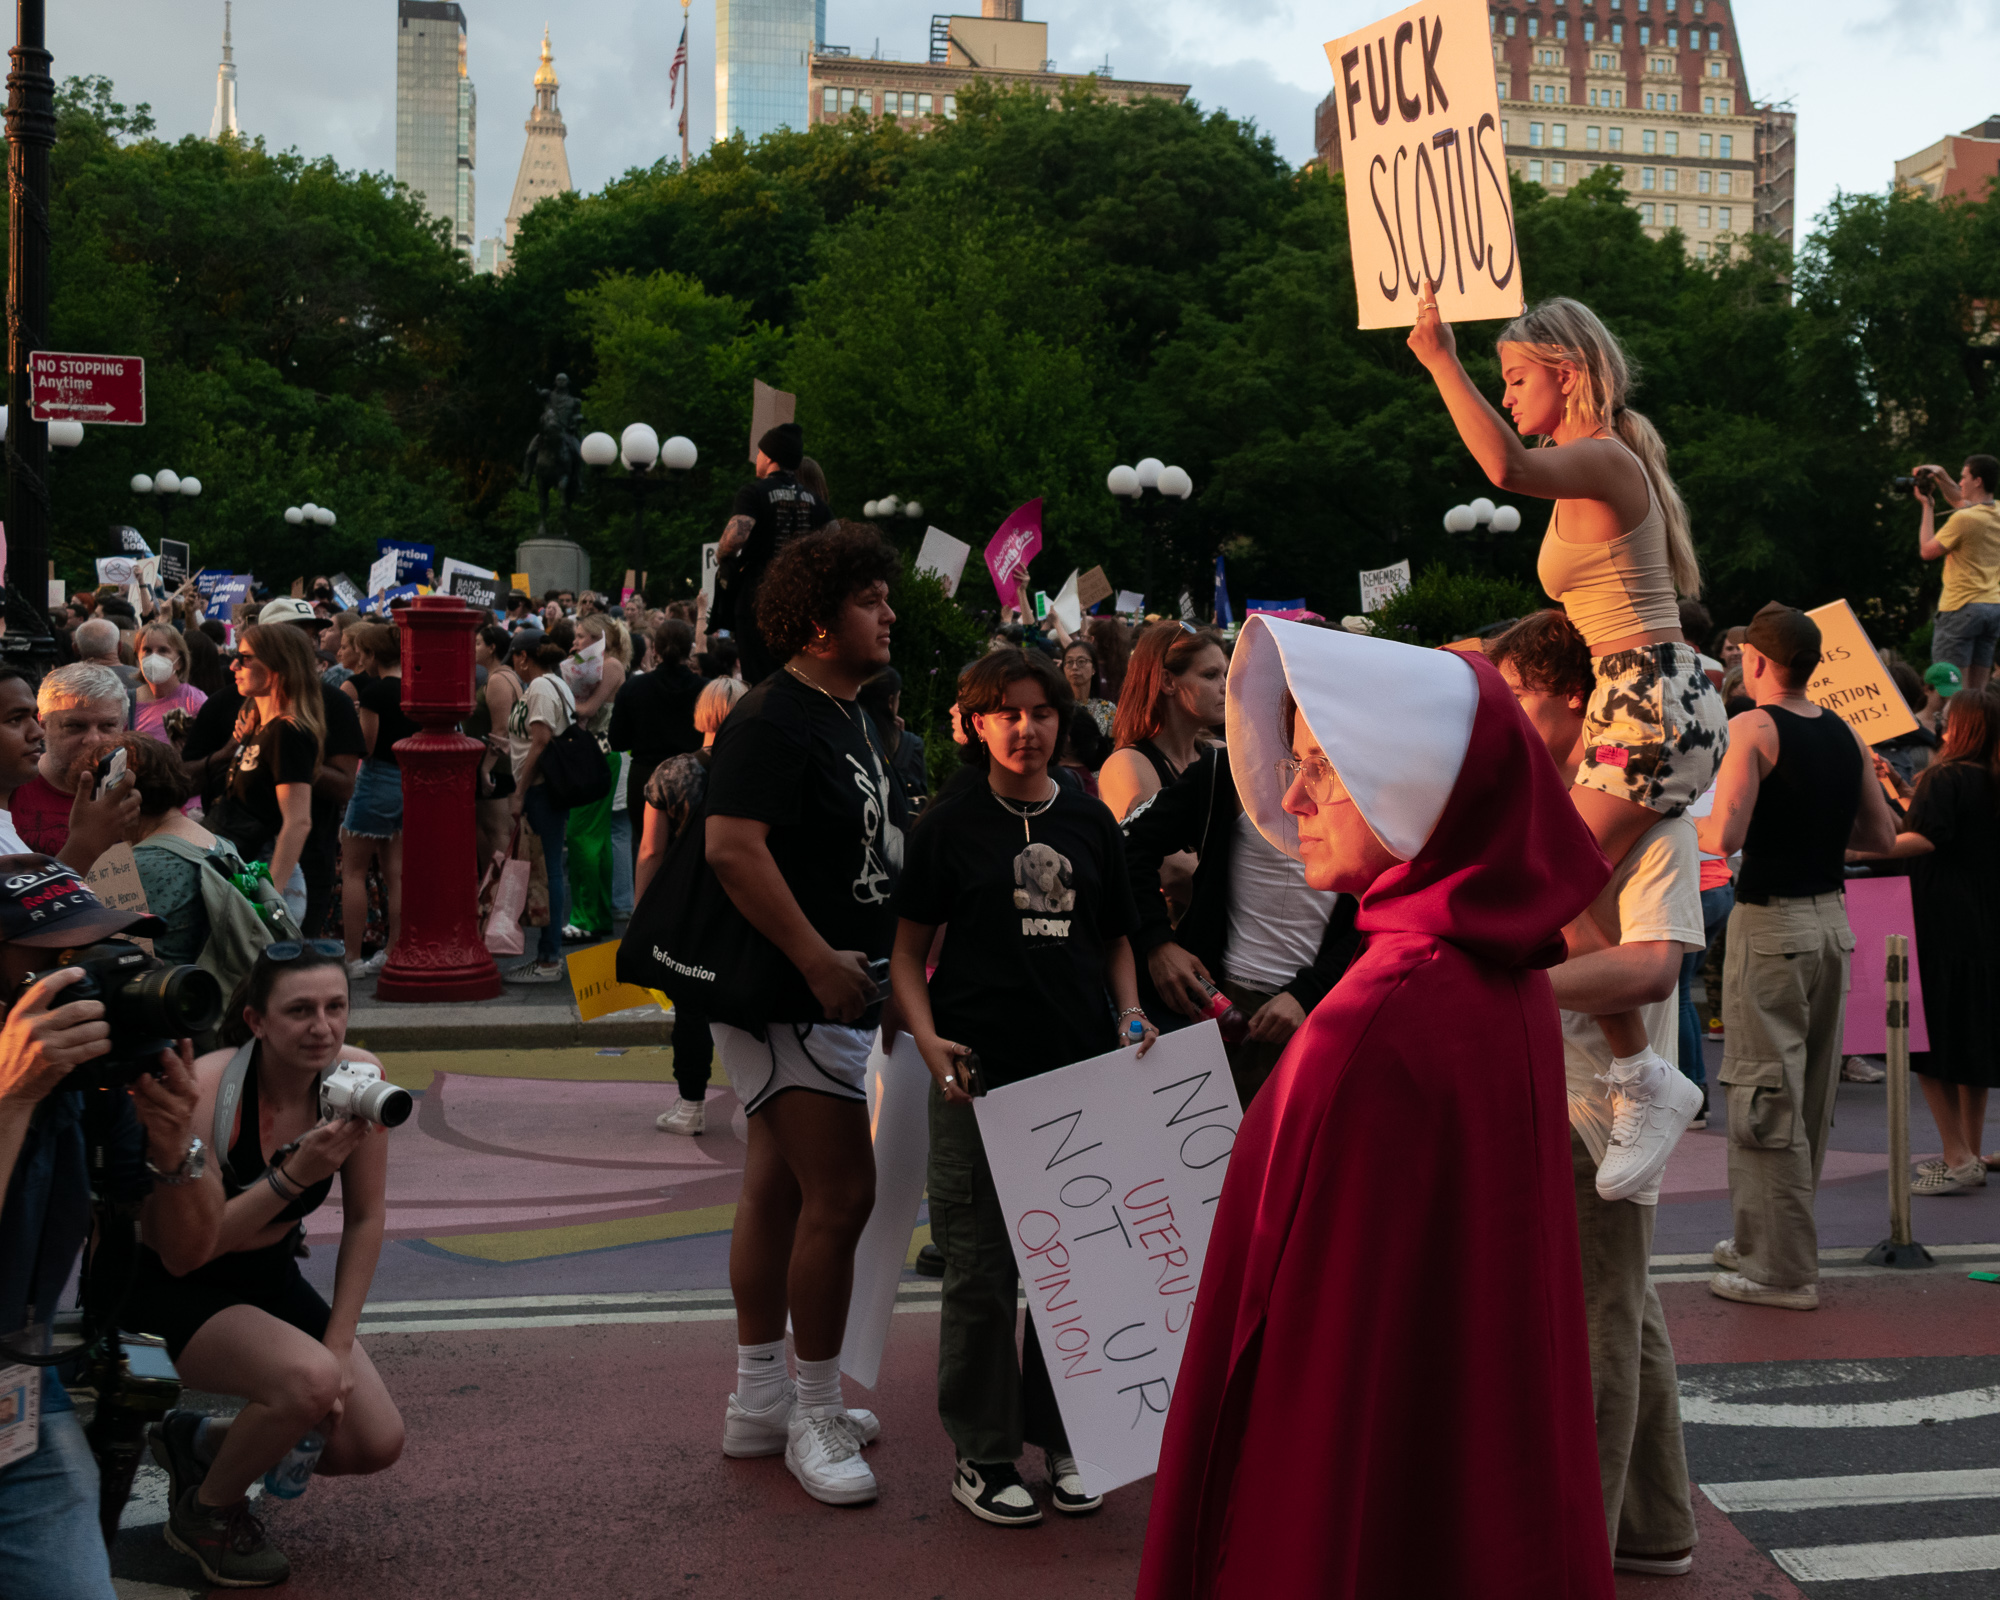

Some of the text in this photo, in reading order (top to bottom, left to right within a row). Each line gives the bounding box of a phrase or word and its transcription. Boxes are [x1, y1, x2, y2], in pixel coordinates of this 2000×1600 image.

[1341, 15, 1449, 141] FUCK
[1370, 113, 1514, 302] SCOTUS
[37, 360, 124, 376] NO STOPPING
[39, 375, 93, 391] Anytime
[456, 578, 481, 588] BANS
[474, 589, 496, 600] OUR
[1362, 569, 1406, 587] REMEMBER
[1022, 918, 1072, 938] IVORY
[652, 944, 716, 982] Reformation
[1153, 1071, 1238, 1206] NO
[1031, 1110, 1172, 1430] NOT UR
[1123, 1178, 1196, 1335] UTERUS
[1017, 1210, 1102, 1380] OPINION
